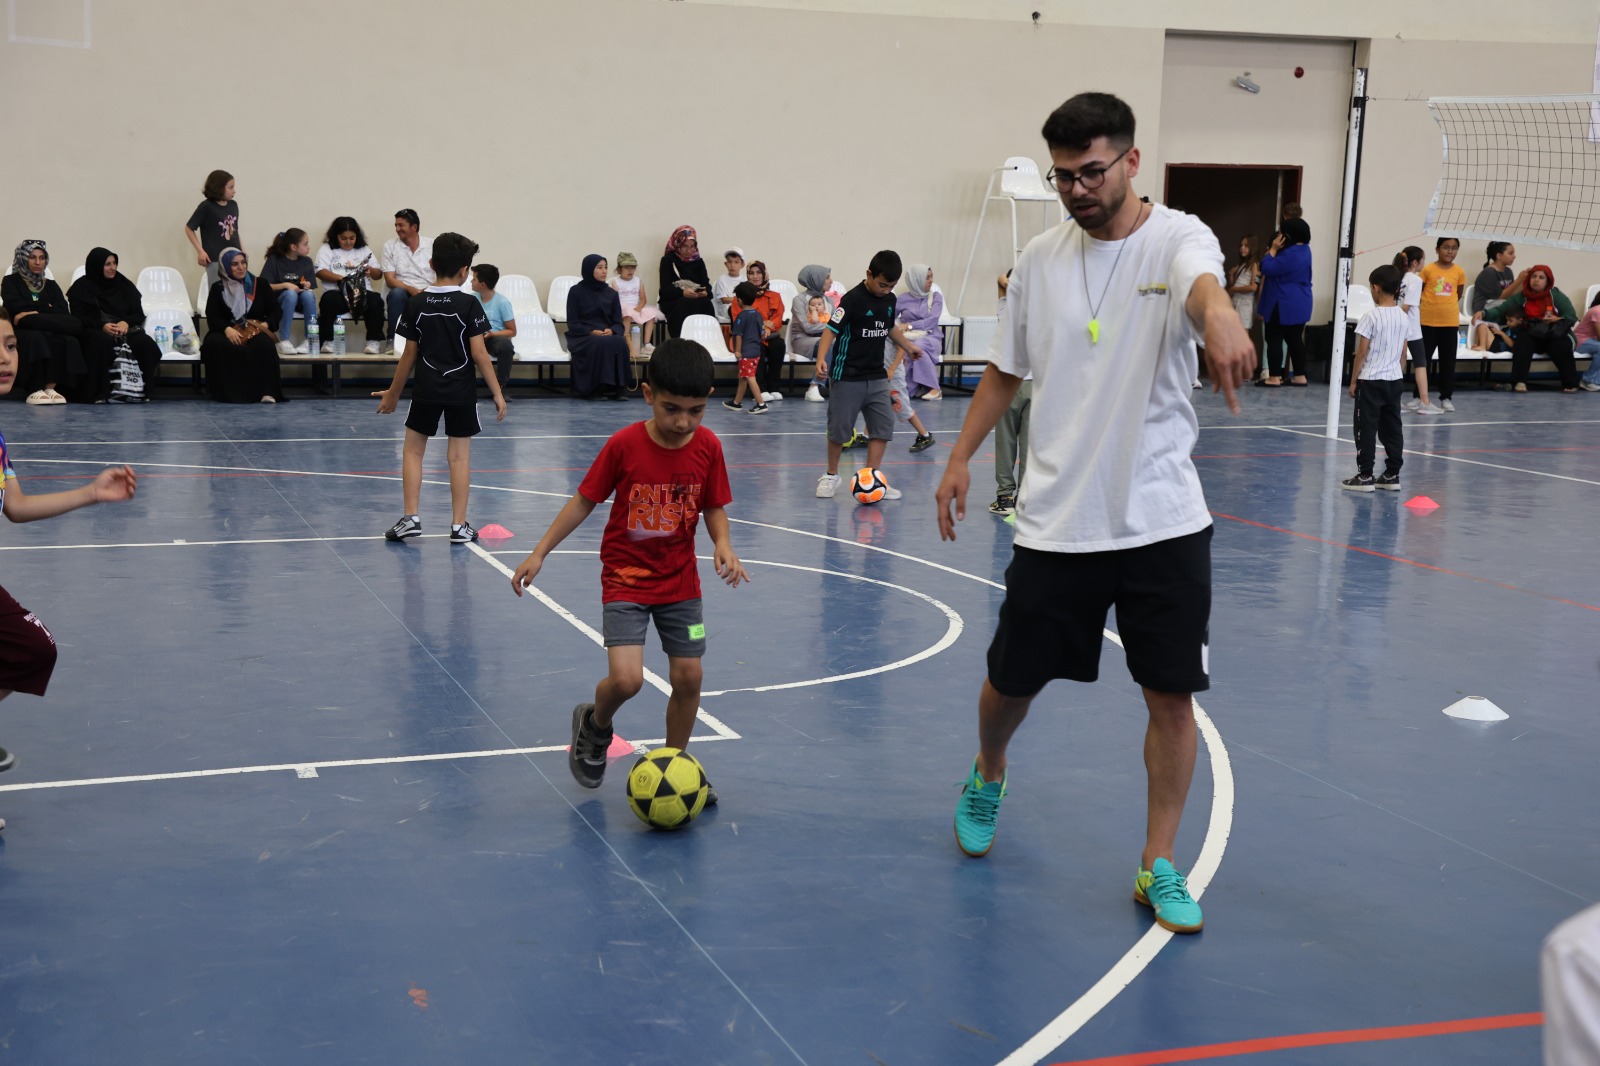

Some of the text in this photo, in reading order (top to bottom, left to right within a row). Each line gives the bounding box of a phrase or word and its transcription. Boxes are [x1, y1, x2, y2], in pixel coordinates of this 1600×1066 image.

[875, 320, 885, 328] Fly
[862, 328, 889, 337] Emira
[628, 483, 661, 504] ON
[627, 502, 697, 533] RISE
